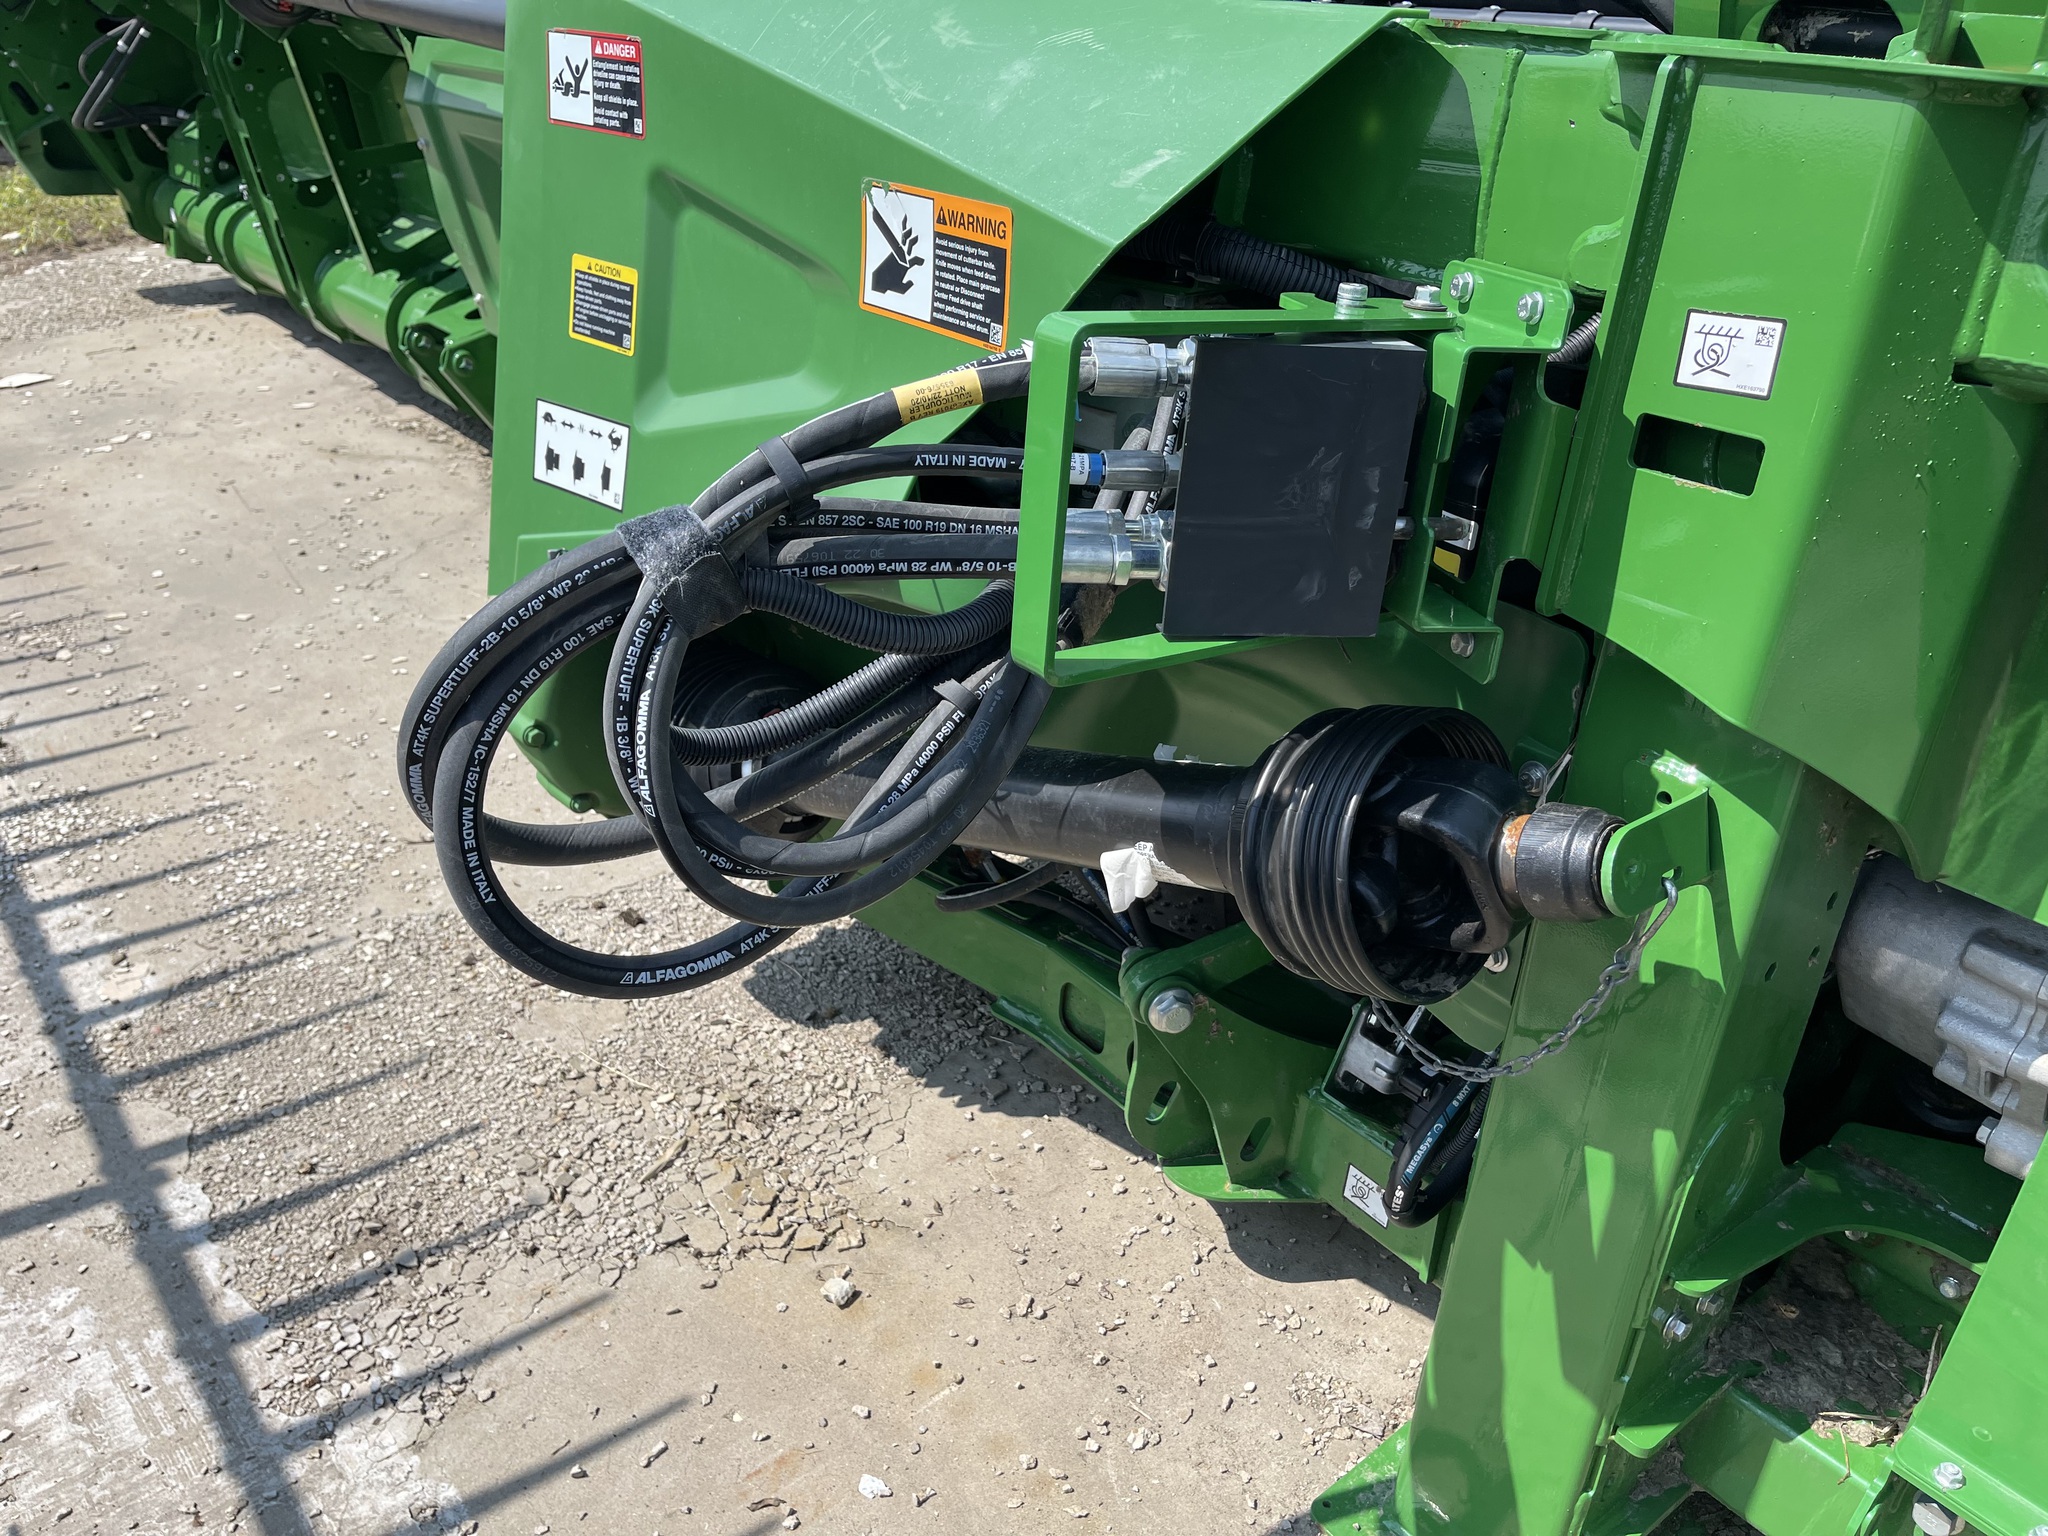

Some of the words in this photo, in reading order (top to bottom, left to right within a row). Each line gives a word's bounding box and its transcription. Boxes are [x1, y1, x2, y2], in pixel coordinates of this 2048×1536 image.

[603, 42, 636, 58] DANGER
[593, 60, 619, 71] Entanglement
[624, 65, 640, 75] rotating
[594, 79, 604, 89] injury
[610, 81, 622, 90] death.
[615, 73, 626, 81] cause
[627, 75, 640, 83] serious
[594, 92, 603, 102] Keep
[609, 95, 622, 104] shields
[627, 98, 639, 107] place.
[595, 106, 605, 116] Avoid
[605, 109, 619, 118] contact
[620, 111, 628, 119] with
[595, 117, 608, 127] rotating
[610, 119, 621, 128] parts.
[948, 209, 1007, 240] WARNING
[935, 237, 948, 247] Avoid
[948, 241, 965, 251] serious
[965, 244, 977, 256] injury
[978, 247, 989, 257] from
[935, 249, 958, 260] movement
[963, 256, 983, 267] cutterbar
[983, 260, 996, 270] knife.
[935, 258, 947, 268] Knife
[947, 262, 961, 272] moves
[962, 266, 974, 276] when
[974, 269, 984, 278] feed
[984, 272, 997, 281] drum
[594, 263, 622, 279] CAUTION
[940, 271, 956, 281] rotated.
[956, 274, 969, 285] Place
[969, 279, 980, 288] main
[980, 282, 1001, 294] gearcase
[940, 281, 955, 291] neutral
[960, 287, 985, 300] Disconnect
[934, 289, 949, 300] Center
[949, 293, 960, 304] Feed
[960, 298, 971, 307] drive
[971, 301, 983, 310] shaft
[933, 301, 945, 310] when
[945, 304, 969, 319] performing
[969, 311, 985, 322] service
[932, 311, 960, 326] maintenance
[966, 321, 976, 331] feed
[976, 324, 990, 335] drum.
[990, 352, 1008, 364] EN
[909, 391, 973, 415] MULTICOUPLER
[1172, 401, 1185, 429] AT3K
[914, 454, 949, 466] ITALY
[952, 455, 966, 467] IN
[969, 455, 1007, 469] MADE
[818, 514, 839, 526] 857
[841, 515, 866, 527] 2SC
[876, 516, 900, 529] SAE
[902, 518, 923, 532] 100
[925, 520, 947, 533] R19
[949, 522, 967, 535] DN
[969, 524, 982, 535] 16
[985, 525, 1019, 536] MSHA
[812, 565, 840, 577] PSI)
[841, 563, 875, 575] (4000
[877, 562, 908, 574] MPa
[911, 562, 927, 572] 28
[930, 562, 953, 572] WP
[956, 561, 984, 572] 5/8"
[585, 614, 615, 636] SAE
[562, 632, 587, 652] 100
[412, 724, 432, 757] AT4K
[423, 615, 520, 725] SUPERTUFF-2B-10
[517, 594, 546, 620] 5/8"
[547, 579, 573, 601] WP
[541, 649, 565, 672] R19
[617, 618, 653, 702] SUPERTUFF
[520, 667, 542, 691] DN
[506, 690, 523, 706] 16
[479, 704, 512, 742] MSHA
[615, 714, 629, 733] 1B
[616, 735, 634, 763] 3/8"
[634, 688, 652, 802] ALFAGOMMA
[897, 767, 920, 794] MPa
[914, 740, 939, 769] (4000
[936, 720, 955, 743] PSI)
[463, 744, 489, 803] IC-152/7
[461, 806, 477, 850] MADE
[467, 851, 481, 868] IN
[471, 868, 497, 905] ITALY
[634, 950, 736, 985] ALFAGOMMA
[739, 930, 771, 954] AT4K
[1458, 1084, 1471, 1101] MXT
[1405, 1136, 1433, 1174] MEGASys
